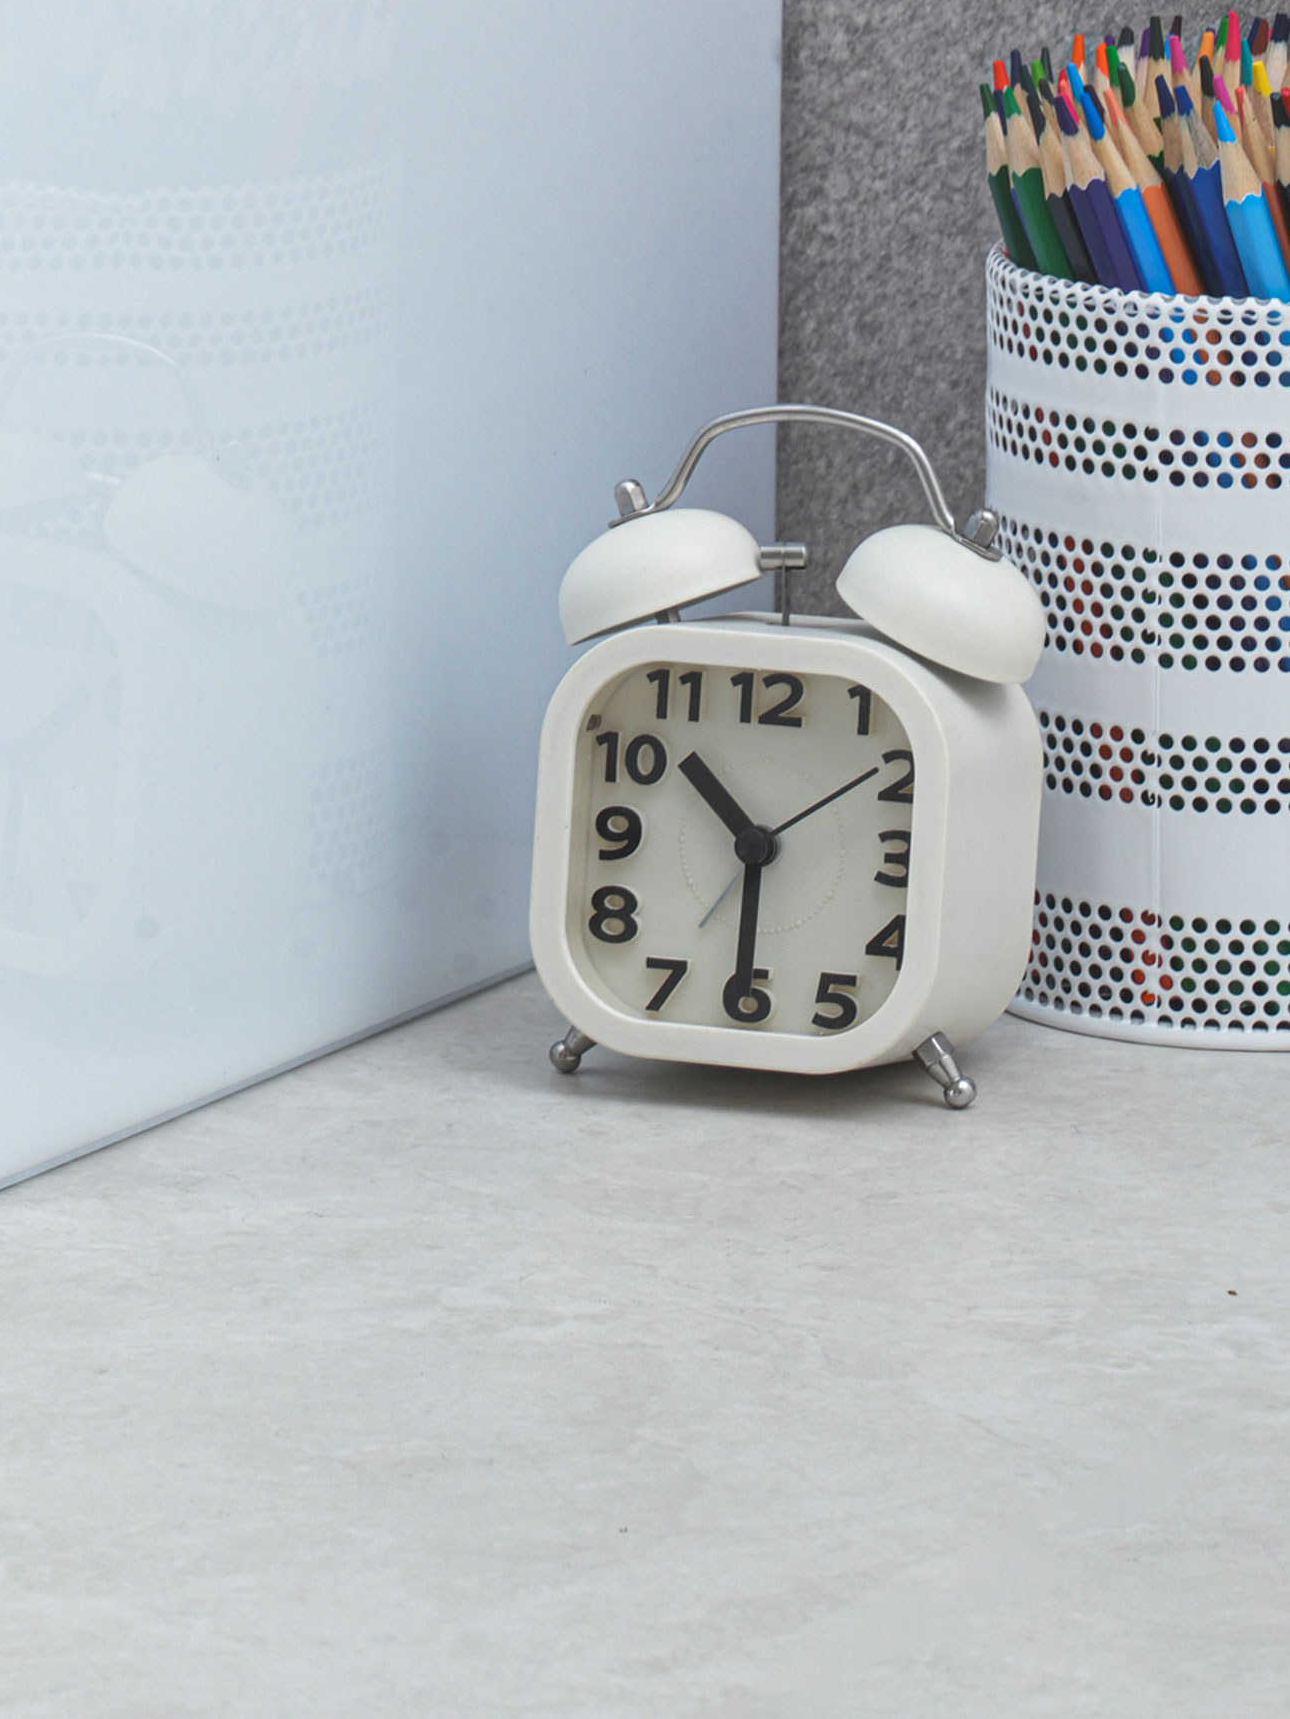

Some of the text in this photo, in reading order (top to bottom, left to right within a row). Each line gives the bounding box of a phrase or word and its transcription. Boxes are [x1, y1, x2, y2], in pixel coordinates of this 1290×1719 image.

[646, 669, 702, 722] 11
[730, 670, 804, 728] 12
[847, 684, 871, 736] 1
[595, 731, 667, 785] 10
[877, 749, 914, 803] 2
[595, 806, 642, 861] 9
[874, 830, 911, 888] 3
[588, 886, 638, 944] 8
[865, 914, 906, 971] 4
[646, 957, 687, 1012] 7
[723, 969, 771, 1024] 6
[812, 972, 858, 1030] 5
